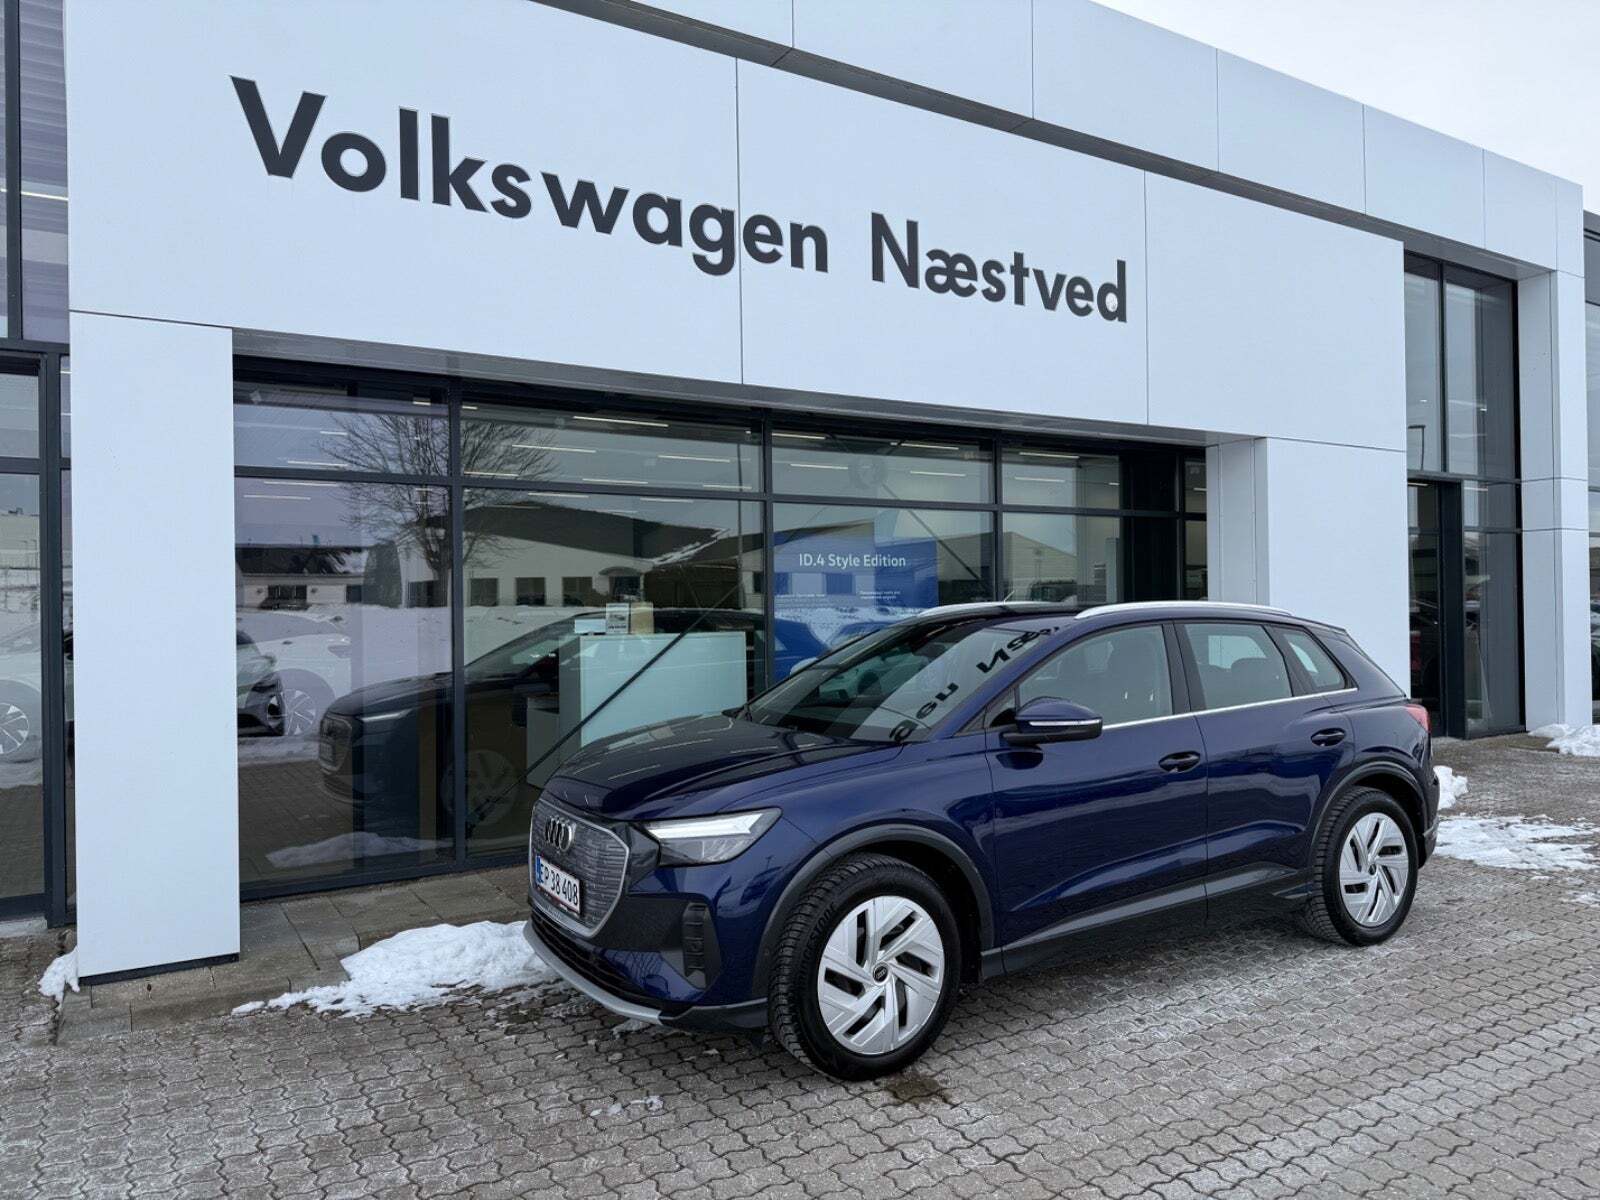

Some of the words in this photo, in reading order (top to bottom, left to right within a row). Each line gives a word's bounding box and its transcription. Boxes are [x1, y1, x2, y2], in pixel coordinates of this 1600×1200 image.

[230, 75, 828, 276] Volkswagen
[871, 212, 1127, 323] Næstved
[799, 553, 825, 567] ID.4
[828, 553, 860, 570] Style
[863, 553, 906, 567] Edition
[551, 869, 561, 895] 38
[562, 878, 579, 906] 408
